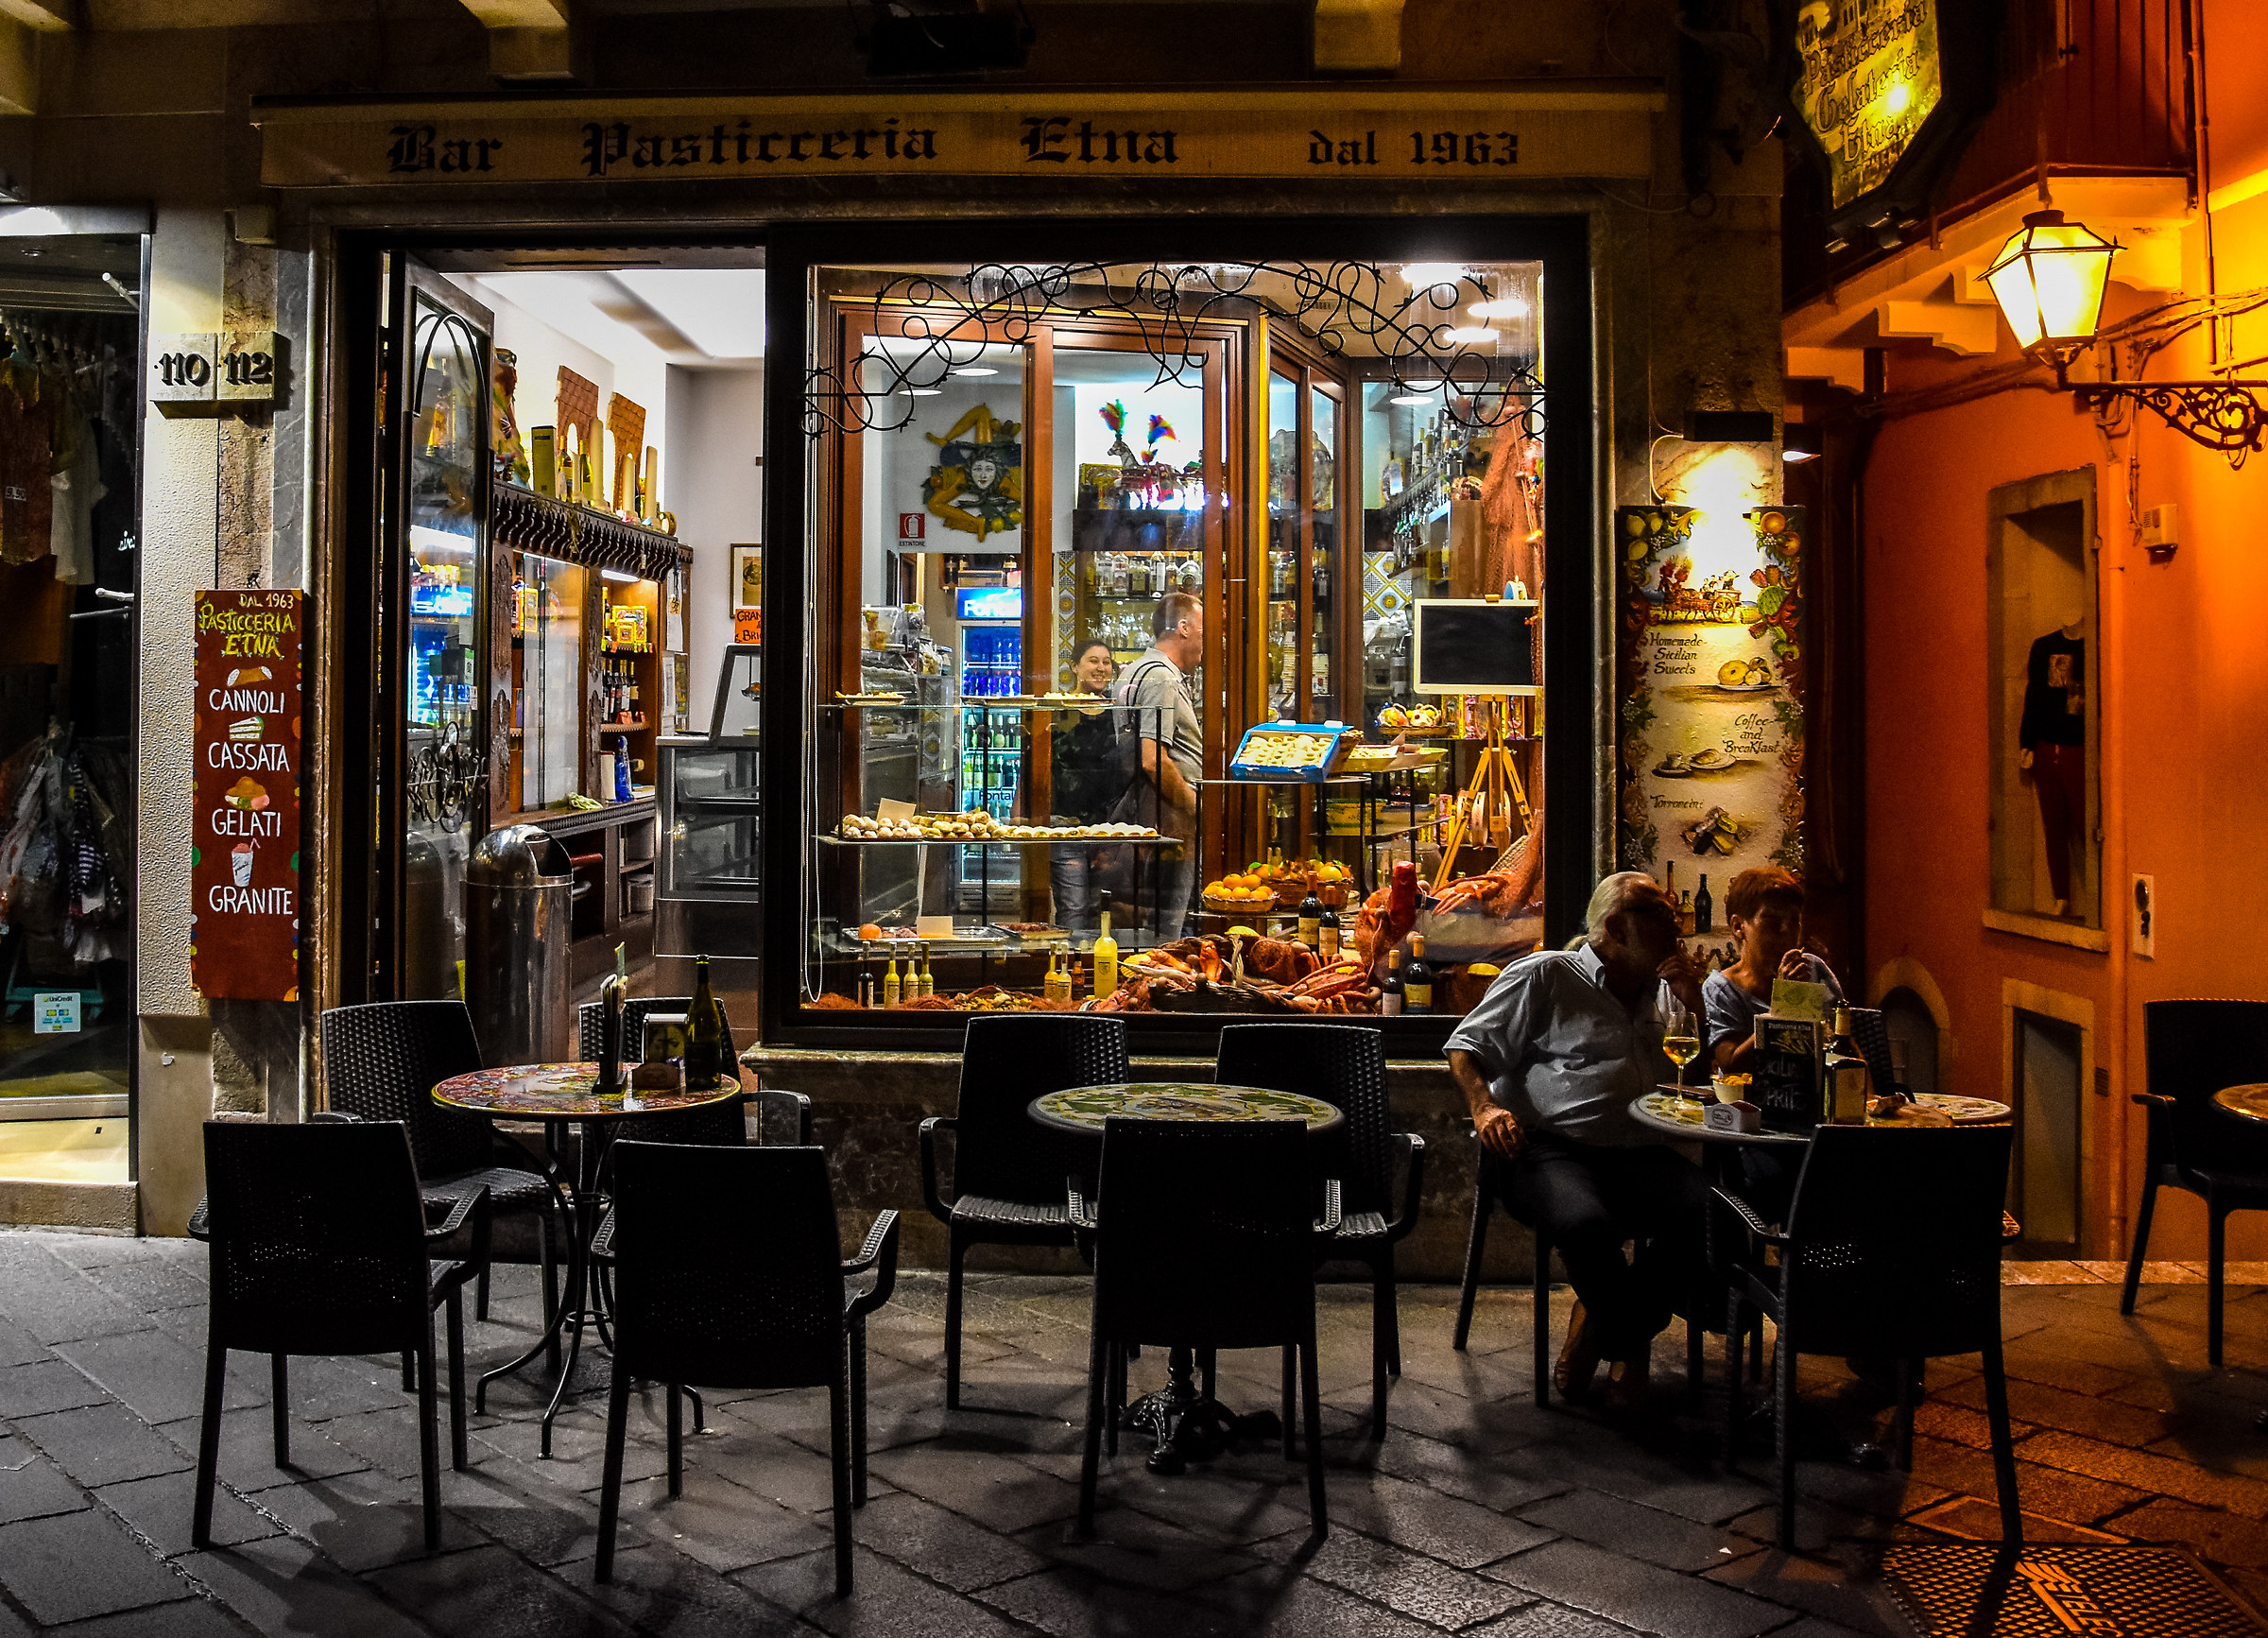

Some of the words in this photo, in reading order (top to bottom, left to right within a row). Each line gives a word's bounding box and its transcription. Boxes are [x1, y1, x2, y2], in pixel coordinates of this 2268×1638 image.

[1815, 47, 1919, 132] Gelateria
[387, 125, 504, 173] Bar
[580, 117, 938, 177] Pasticceria
[1020, 116, 1179, 164] Etna
[1307, 129, 1379, 165] dal
[1409, 130, 1520, 166] 1963
[1841, 112, 1899, 163] Etna
[158, 352, 210, 387] 110
[223, 352, 273, 386] 112
[239, 594, 264, 608] DAL
[266, 593, 294, 609] 1963
[199, 603, 297, 633] PASTICCERIA
[226, 632, 282, 657] ETNA
[1649, 631, 1705, 647] Homemade
[1654, 647, 1697, 661] Sicilian
[1654, 662, 1696, 675] Sweets
[209, 688, 284, 714] CANNOLI
[1734, 713, 1776, 730] Coffee
[1740, 727, 1763, 740] and
[209, 742, 290, 772] CASSATA
[212, 808, 281, 836] GELATI
[209, 885, 293, 915] GRANITE
